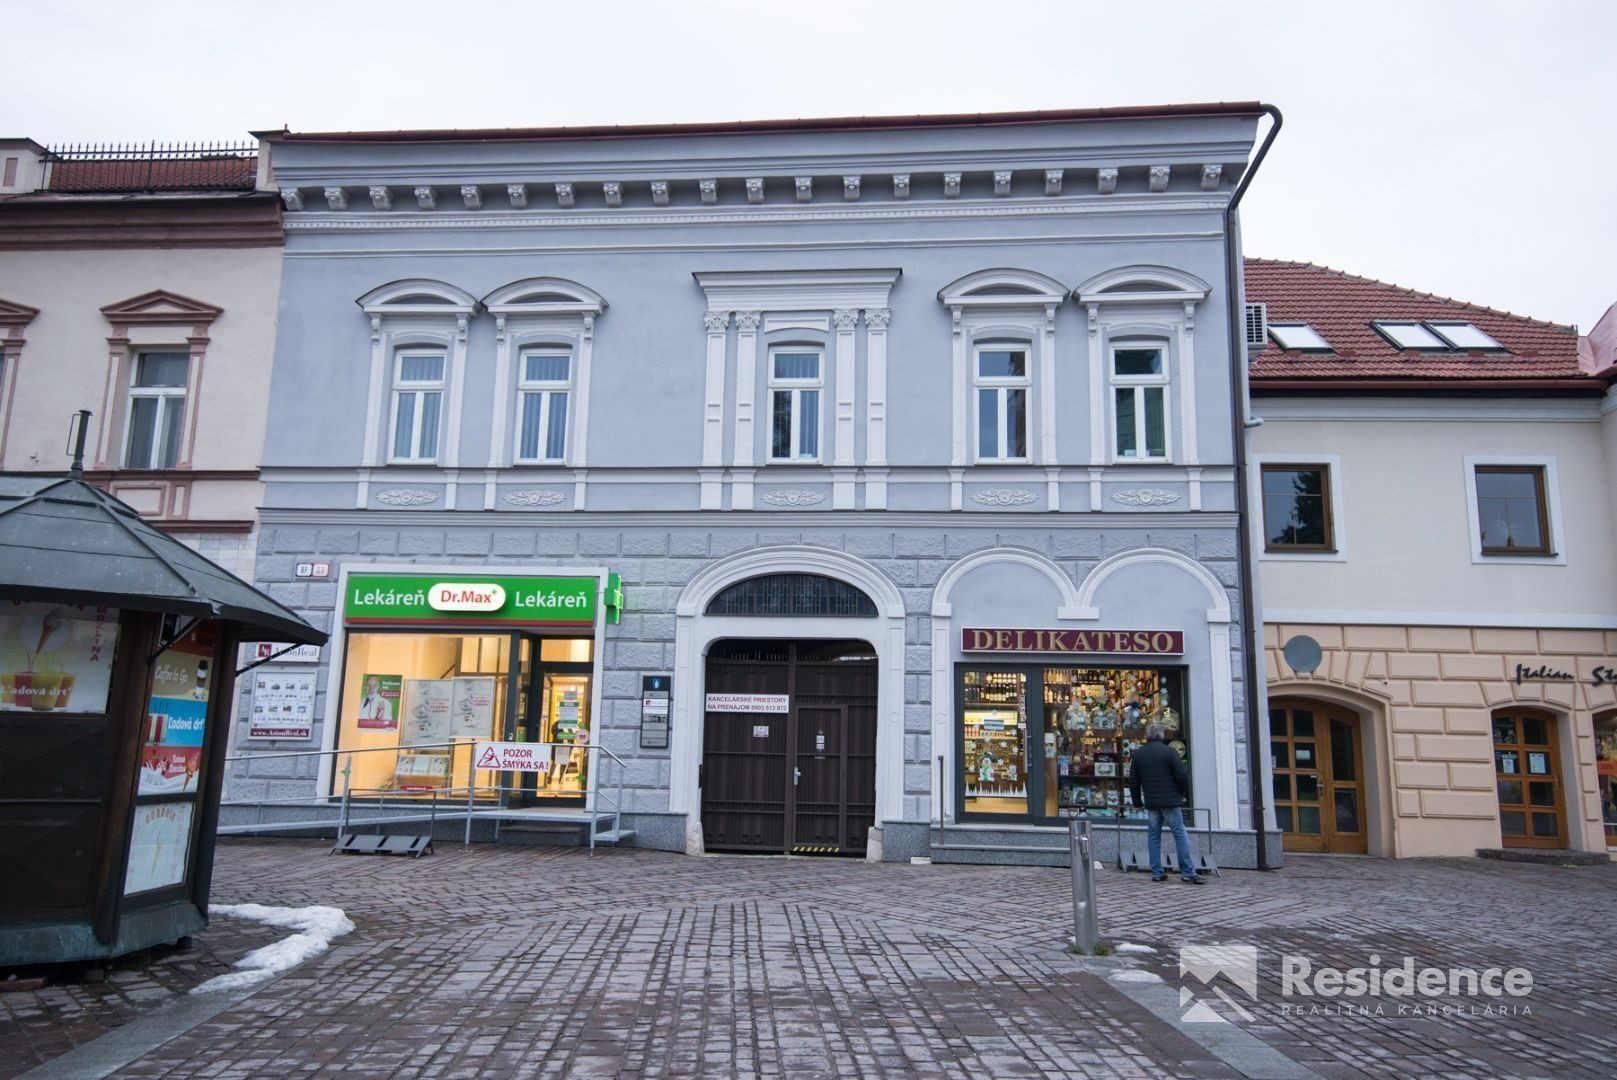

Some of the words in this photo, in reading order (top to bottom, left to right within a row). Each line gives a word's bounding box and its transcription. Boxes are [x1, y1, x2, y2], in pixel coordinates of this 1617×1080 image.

[354, 589, 425, 606] Lekáreň
[440, 590, 492, 603] Dr.Max
[515, 591, 587, 608] Lekáreň
[972, 630, 1174, 652] DELIKATESO
[154, 664, 173, 684] Coffee
[1516, 663, 1575, 685] Italian
[1592, 665, 1617, 686] St
[167, 717, 193, 730] Ľadová
[503, 748, 532, 758] POZOR
[502, 759, 531, 769] ŠMÝKA
